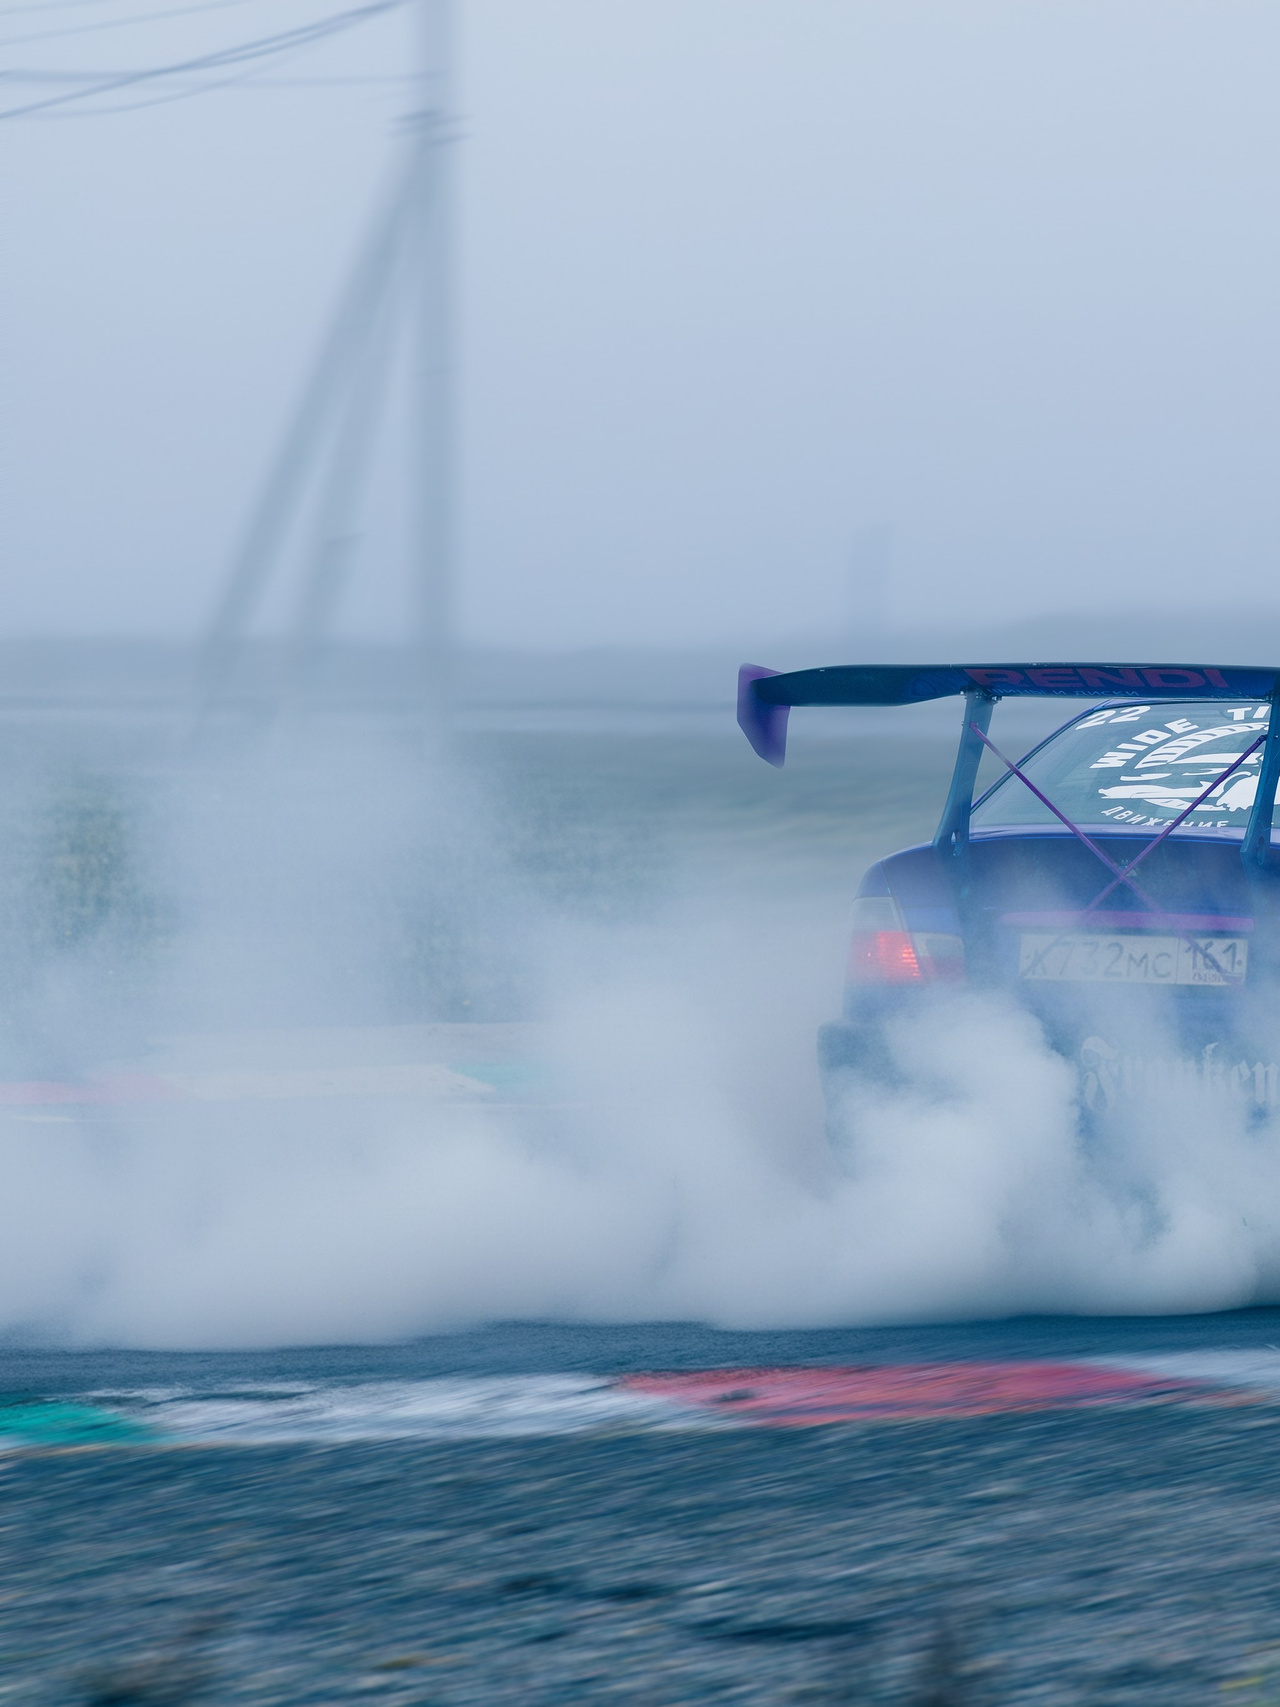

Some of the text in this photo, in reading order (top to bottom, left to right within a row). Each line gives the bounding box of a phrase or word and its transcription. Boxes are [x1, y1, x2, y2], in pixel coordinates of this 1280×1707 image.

[963, 667, 1229, 688] RENDI
[1075, 705, 1151, 730] 22
[1089, 718, 1199, 770] WIDE
